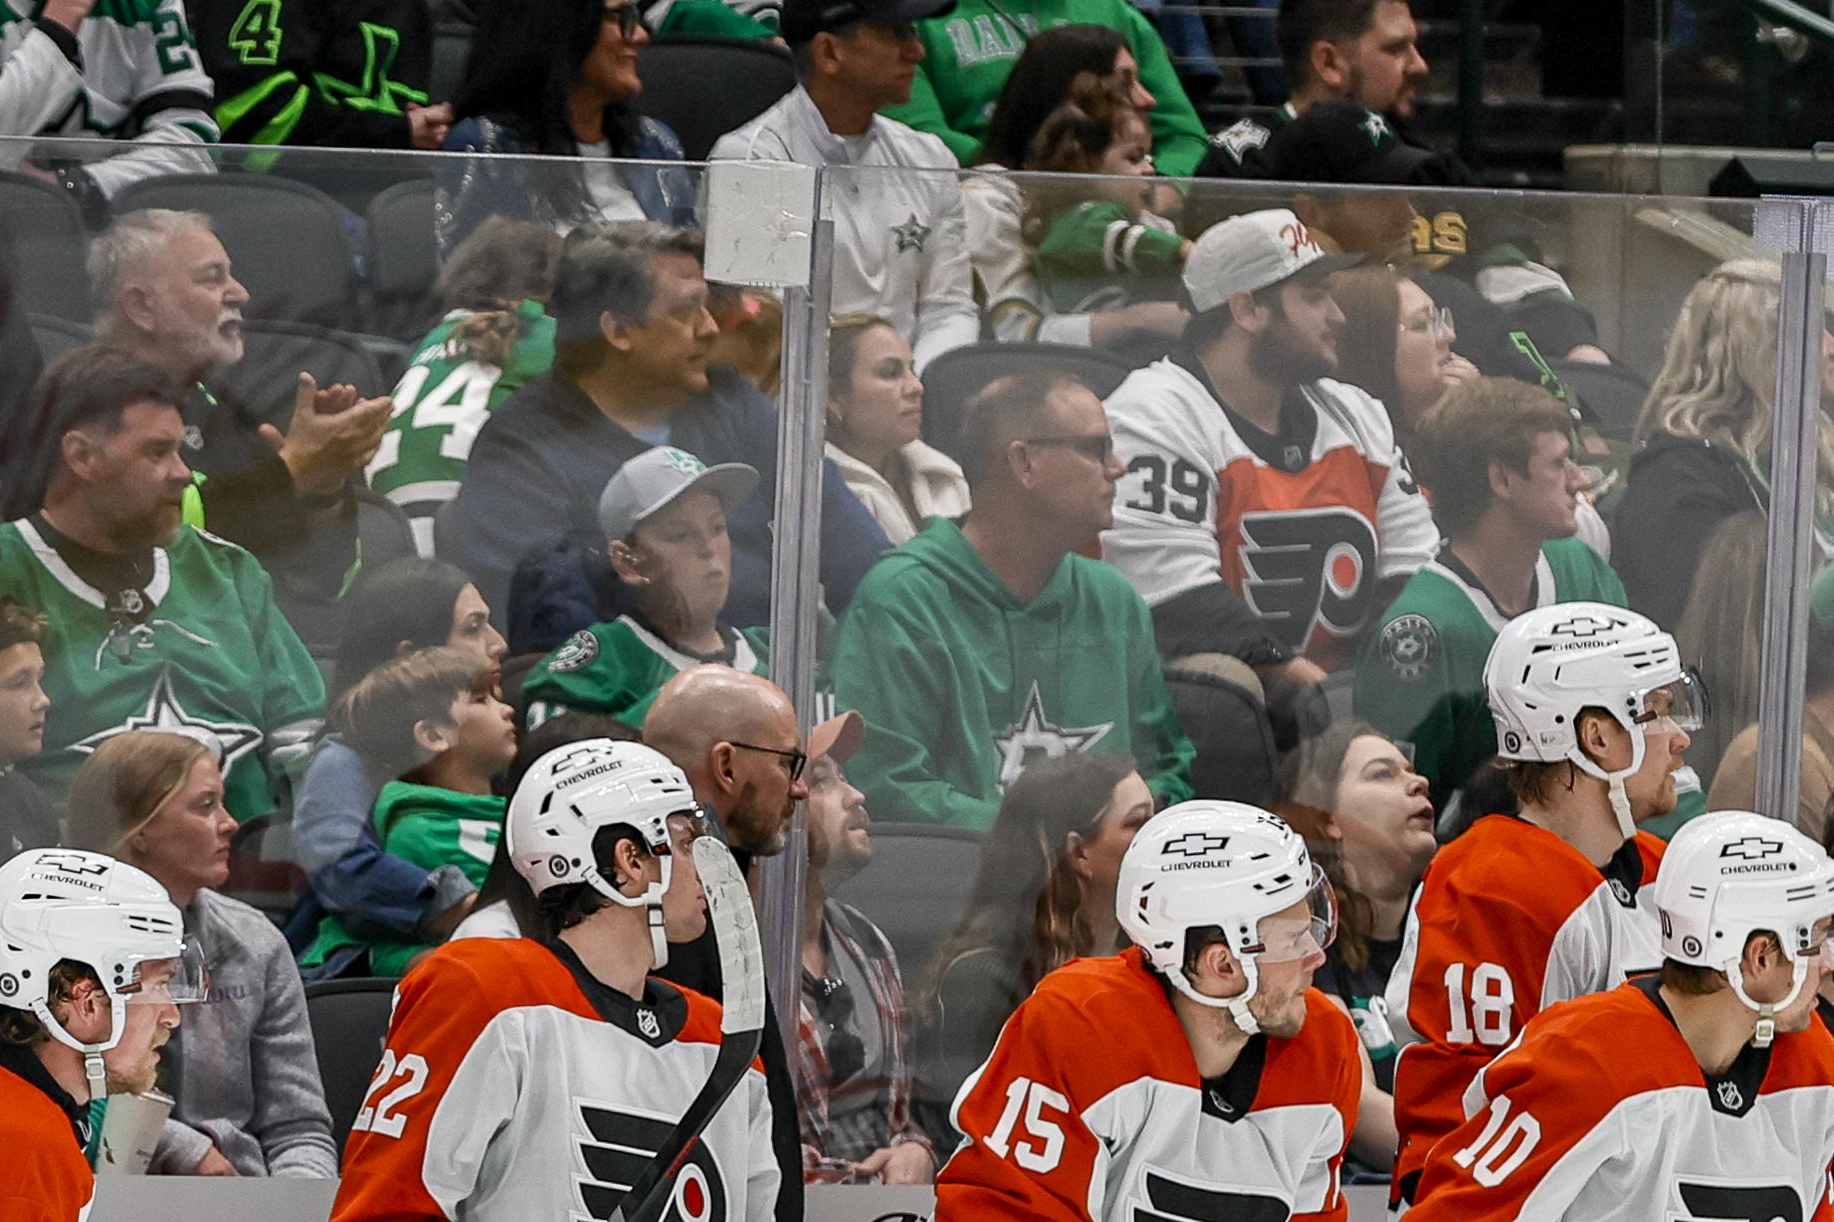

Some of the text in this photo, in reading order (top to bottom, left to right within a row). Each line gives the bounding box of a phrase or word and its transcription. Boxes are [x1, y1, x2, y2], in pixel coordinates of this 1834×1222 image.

[229, 0, 283, 65] 4
[1125, 453, 1209, 523] 39
[555, 759, 624, 791] CHEVROLET
[1161, 859, 1232, 873] CHEVROLET
[1720, 863, 1788, 875] CHEVROLET
[1444, 962, 1514, 1046] 18
[352, 1048, 429, 1139] 22
[983, 1075, 1070, 1179] 15
[1452, 1094, 1542, 1188] 10
